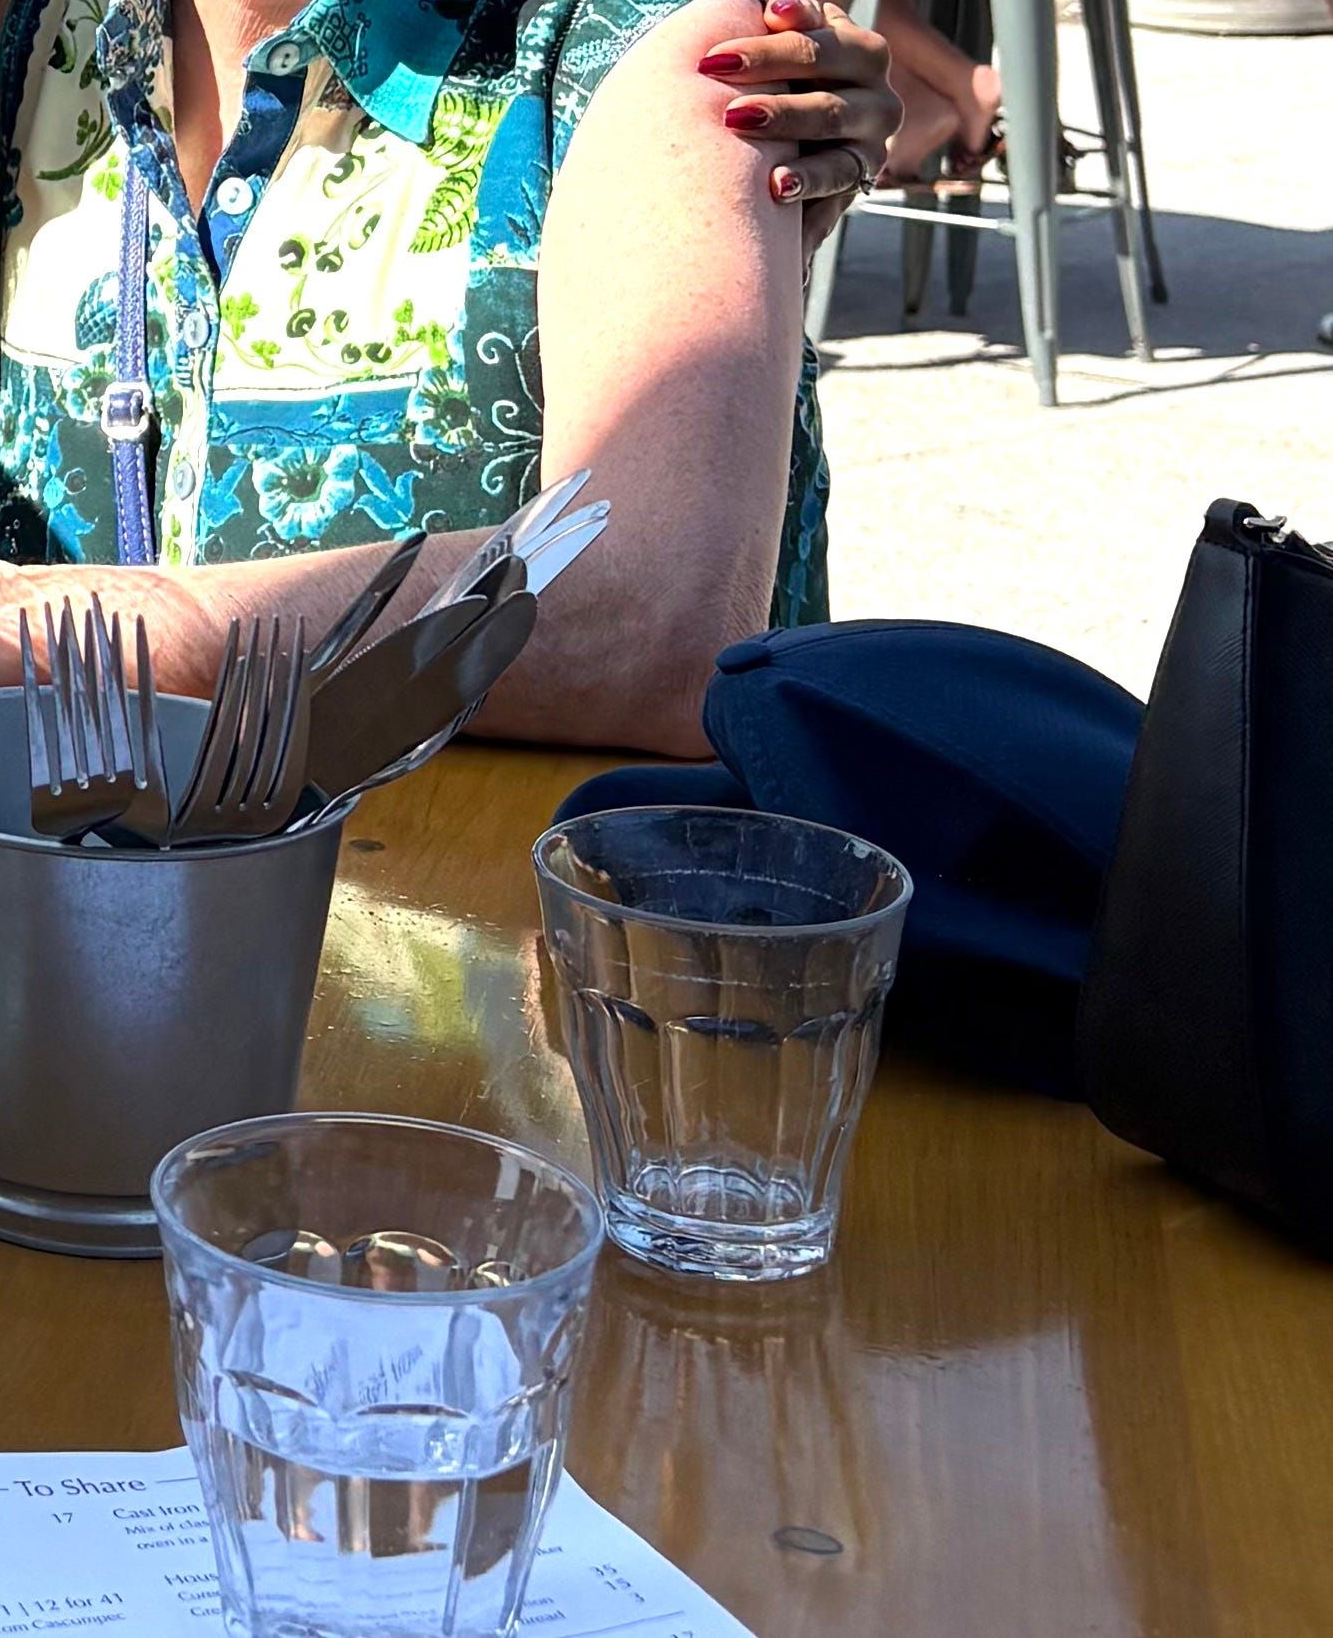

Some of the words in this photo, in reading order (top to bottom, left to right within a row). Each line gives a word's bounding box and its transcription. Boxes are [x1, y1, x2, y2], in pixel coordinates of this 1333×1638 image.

[13, 1479, 55, 1498] To
[61, 1477, 148, 1496] Share
[52, 1512, 73, 1524] 17
[112, 1507, 154, 1520] Cast
[162, 1503, 201, 1516] Iron
[124, 1525, 156, 1535] Mix
[159, 1521, 176, 1532] of
[179, 1519, 211, 1530] clas
[137, 1538, 176, 1550] oven
[178, 1536, 196, 1546] in
[164, 1572, 220, 1587] Hous
[34, 1599, 60, 1612] 12
[64, 1596, 92, 1609] for
[99, 1592, 124, 1605] 41
[31, 1611, 127, 1631] Cascumpec
